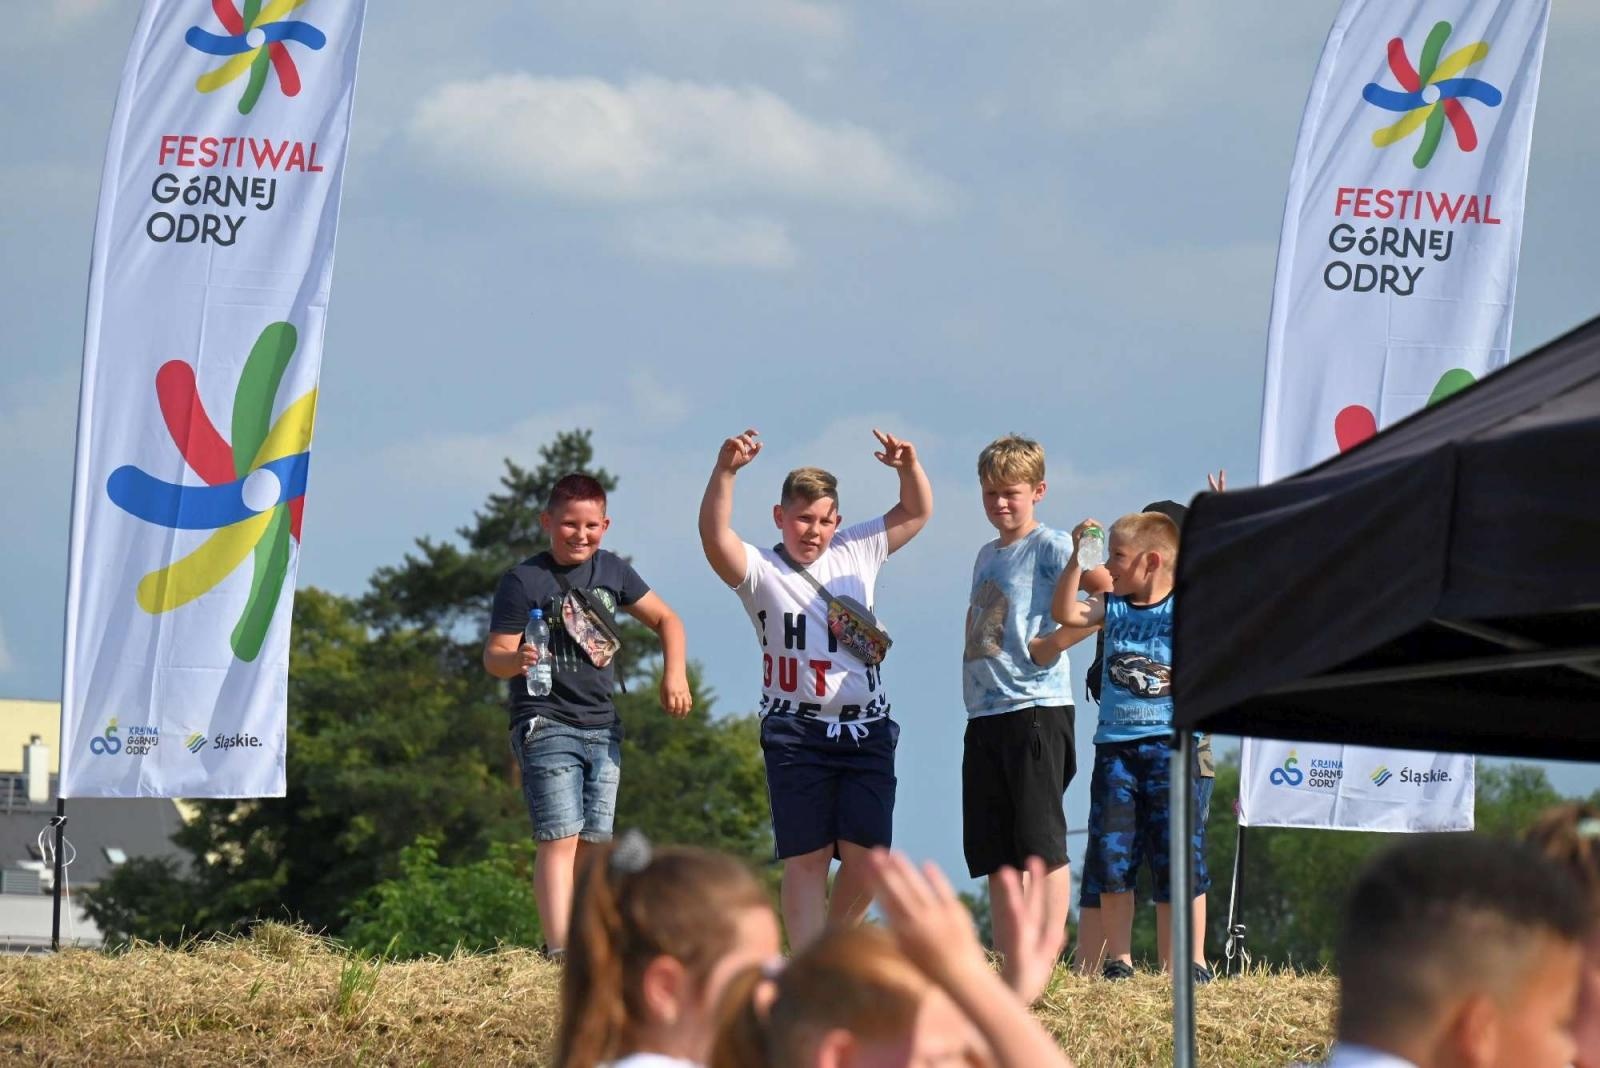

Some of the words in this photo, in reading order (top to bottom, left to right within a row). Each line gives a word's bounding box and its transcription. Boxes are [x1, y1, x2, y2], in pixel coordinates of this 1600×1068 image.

[158, 135, 324, 172] FESTIWAL
[1334, 187, 1501, 225] FESTIWAL
[146, 211, 247, 247] ODRY
[1323, 260, 1425, 296] ODRY
[125, 745, 151, 756] ODRY
[213, 733, 263, 752] Śląskie.
[1310, 758, 1344, 769] KRAINA
[1308, 778, 1336, 788] ODRY
[1399, 767, 1453, 786] Śląskie.
